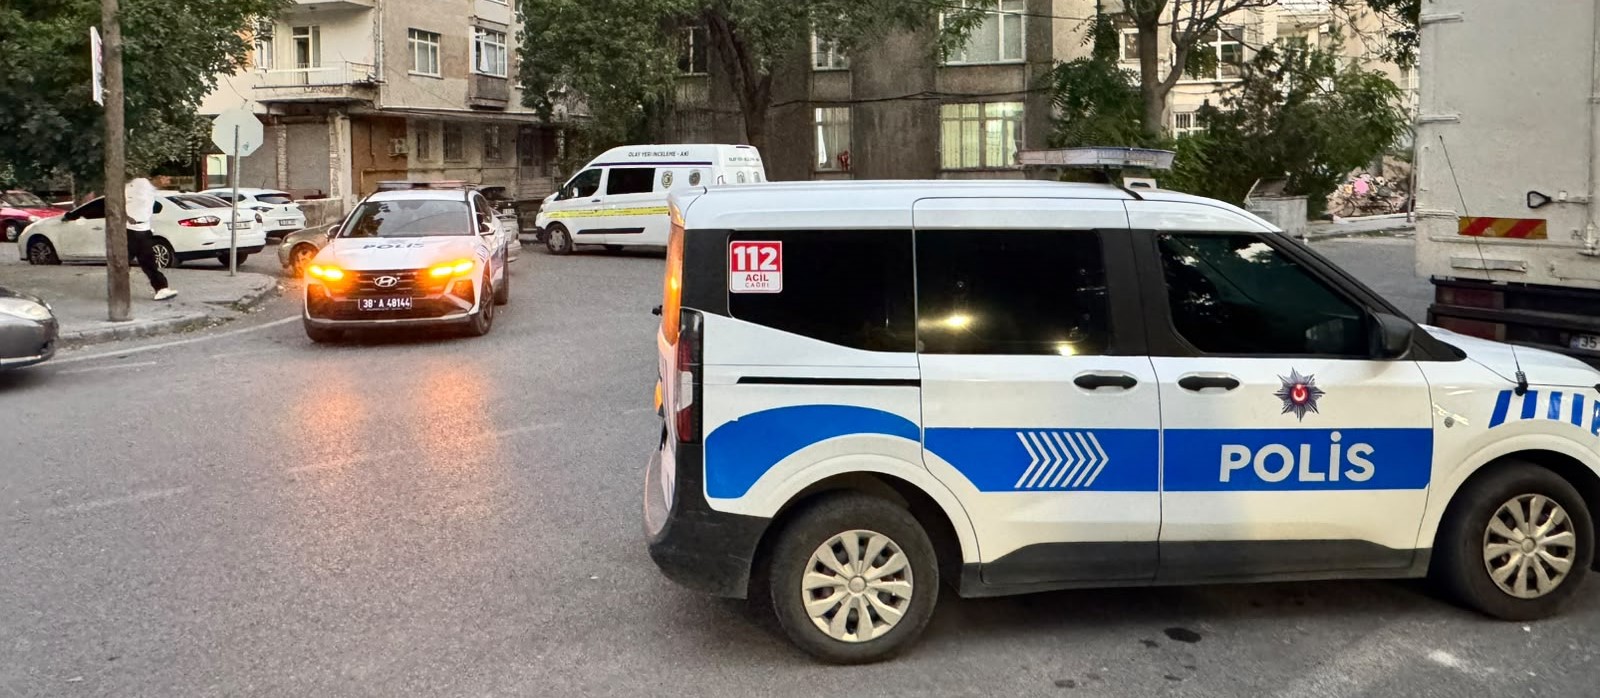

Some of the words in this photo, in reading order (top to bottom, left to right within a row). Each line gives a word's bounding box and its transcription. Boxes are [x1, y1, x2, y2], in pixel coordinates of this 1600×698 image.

[733, 246, 777, 270] 112
[363, 299, 373, 308] 38
[378, 298, 385, 308] A
[386, 297, 410, 308] 48144
[1580, 335, 1597, 348] 35
[1219, 431, 1375, 482] POLİS
